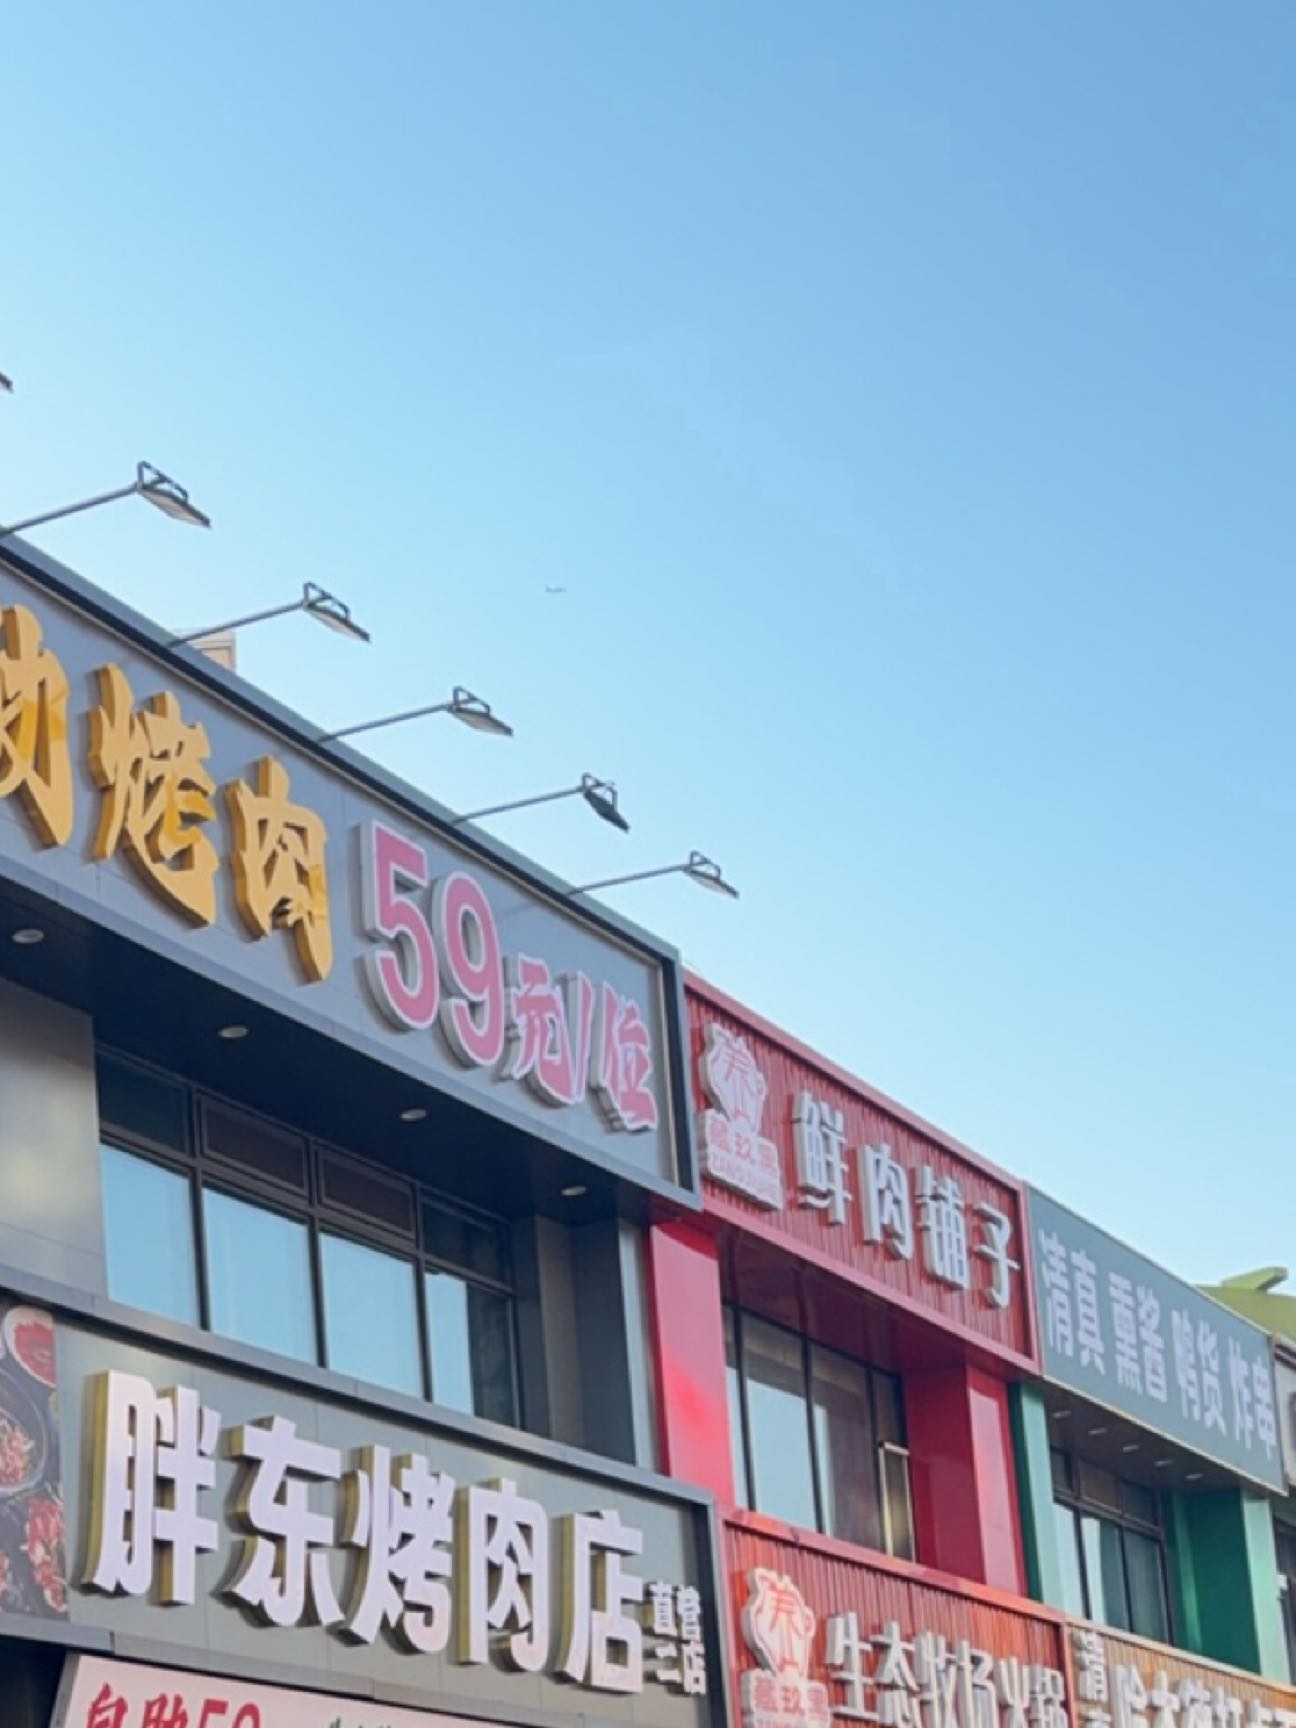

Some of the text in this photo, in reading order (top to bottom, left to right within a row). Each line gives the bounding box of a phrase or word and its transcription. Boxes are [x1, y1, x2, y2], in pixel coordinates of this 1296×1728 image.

[356, 818, 659, 1133] 59元/位
[792, 1090, 1022, 1308] 鲜肉铺子
[1038, 1228, 1106, 1376] 清真
[84, 1368, 646, 1694] 胖东烤肉店
[648, 1582, 702, 1642] 直营
[644, 1640, 707, 1696] 二店
